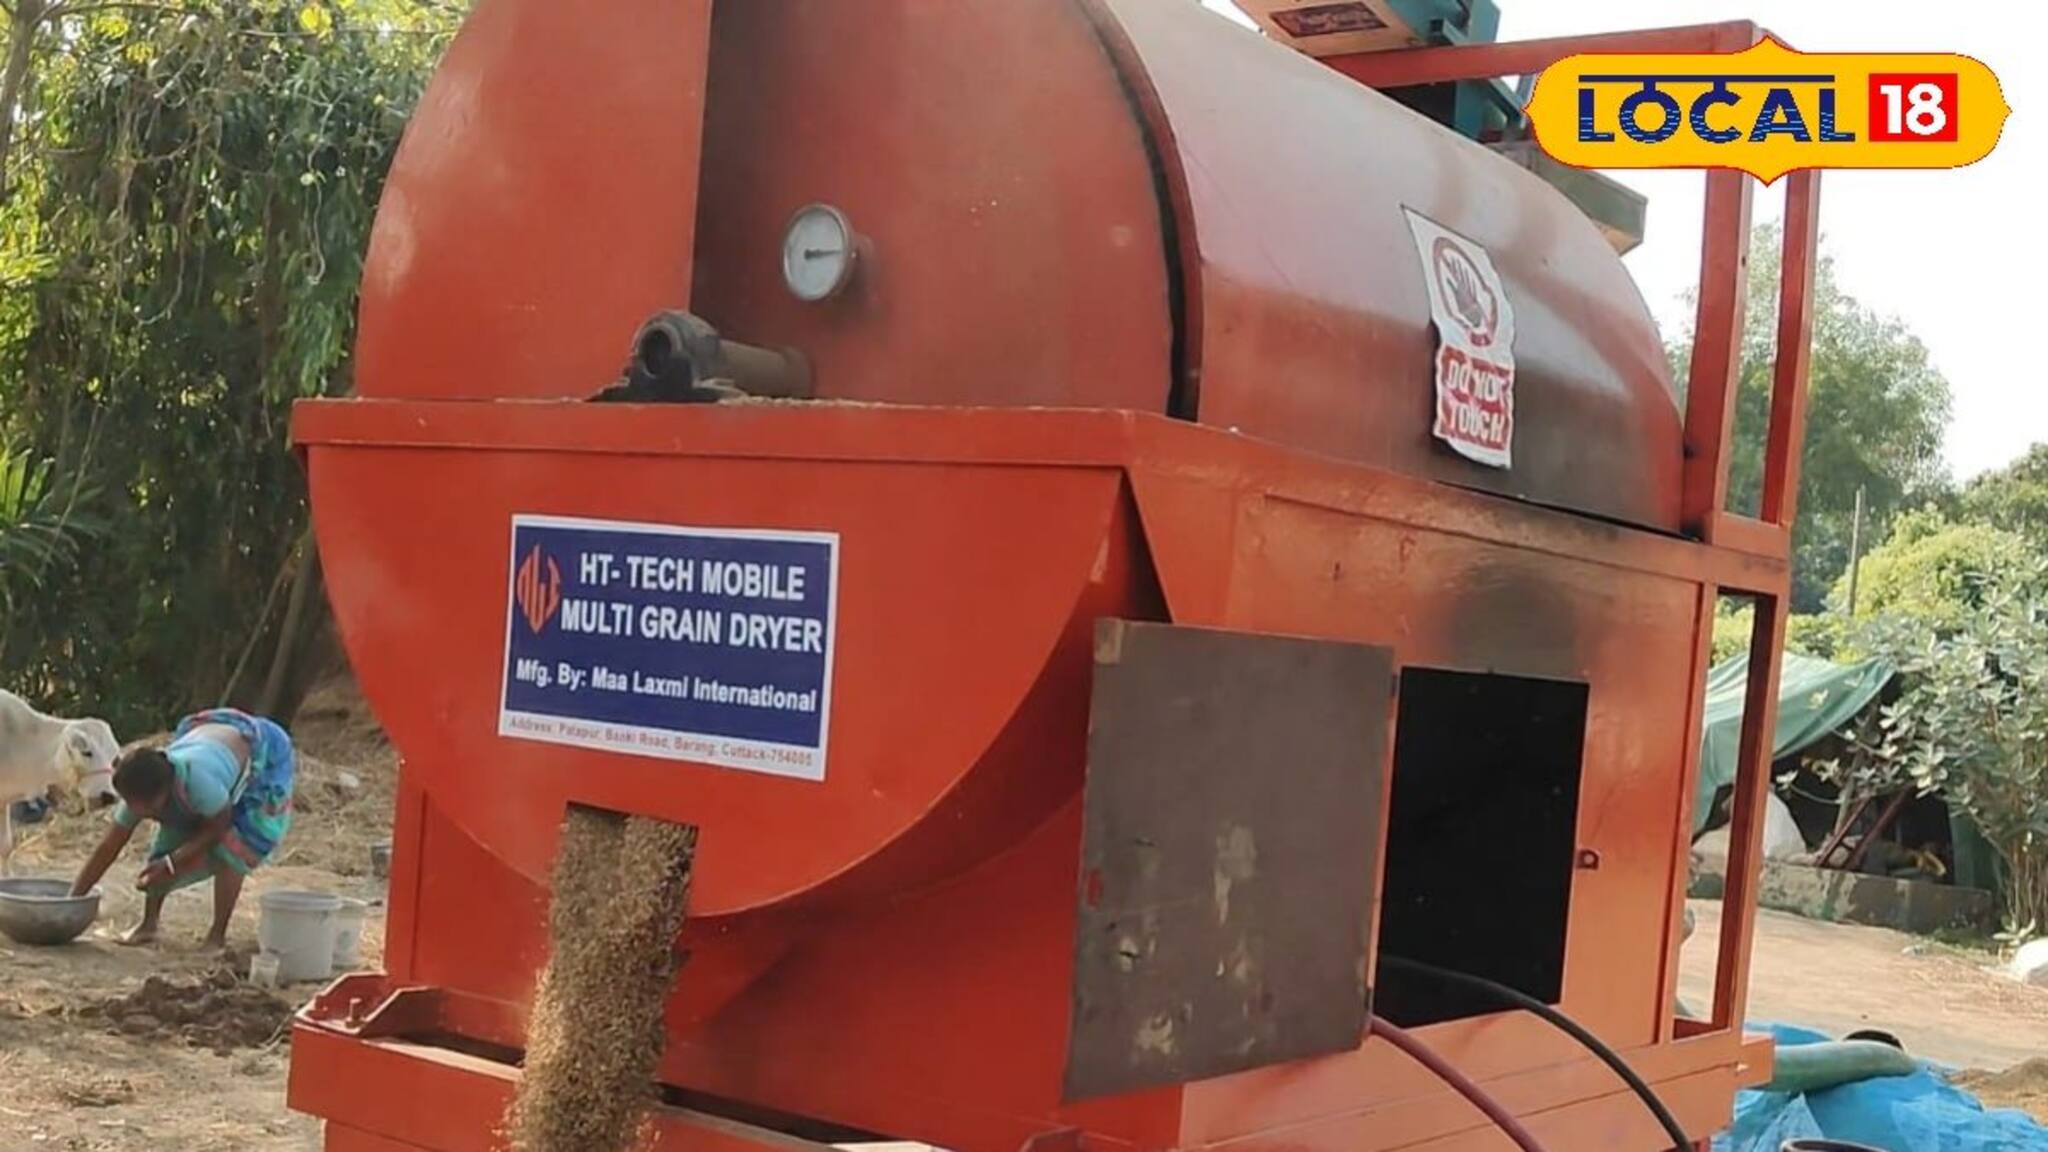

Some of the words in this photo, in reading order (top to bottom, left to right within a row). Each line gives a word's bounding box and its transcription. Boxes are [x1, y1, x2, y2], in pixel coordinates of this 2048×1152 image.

[1447, 360, 1470, 393] DO
[1471, 368, 1507, 402] NOT
[1446, 398, 1505, 443] TOUCH
[580, 552, 621, 586] HT-
[626, 555, 694, 592] TECH
[702, 560, 806, 601] MOBILE
[561, 598, 634, 637] MULTI
[640, 605, 721, 645] GRAIN
[729, 612, 823, 654] DRYER
[516, 658, 553, 688] Mfg.
[557, 662, 587, 691] By:
[592, 666, 628, 692] Maa
[632, 670, 689, 699] Laxmi
[693, 676, 817, 712] International
